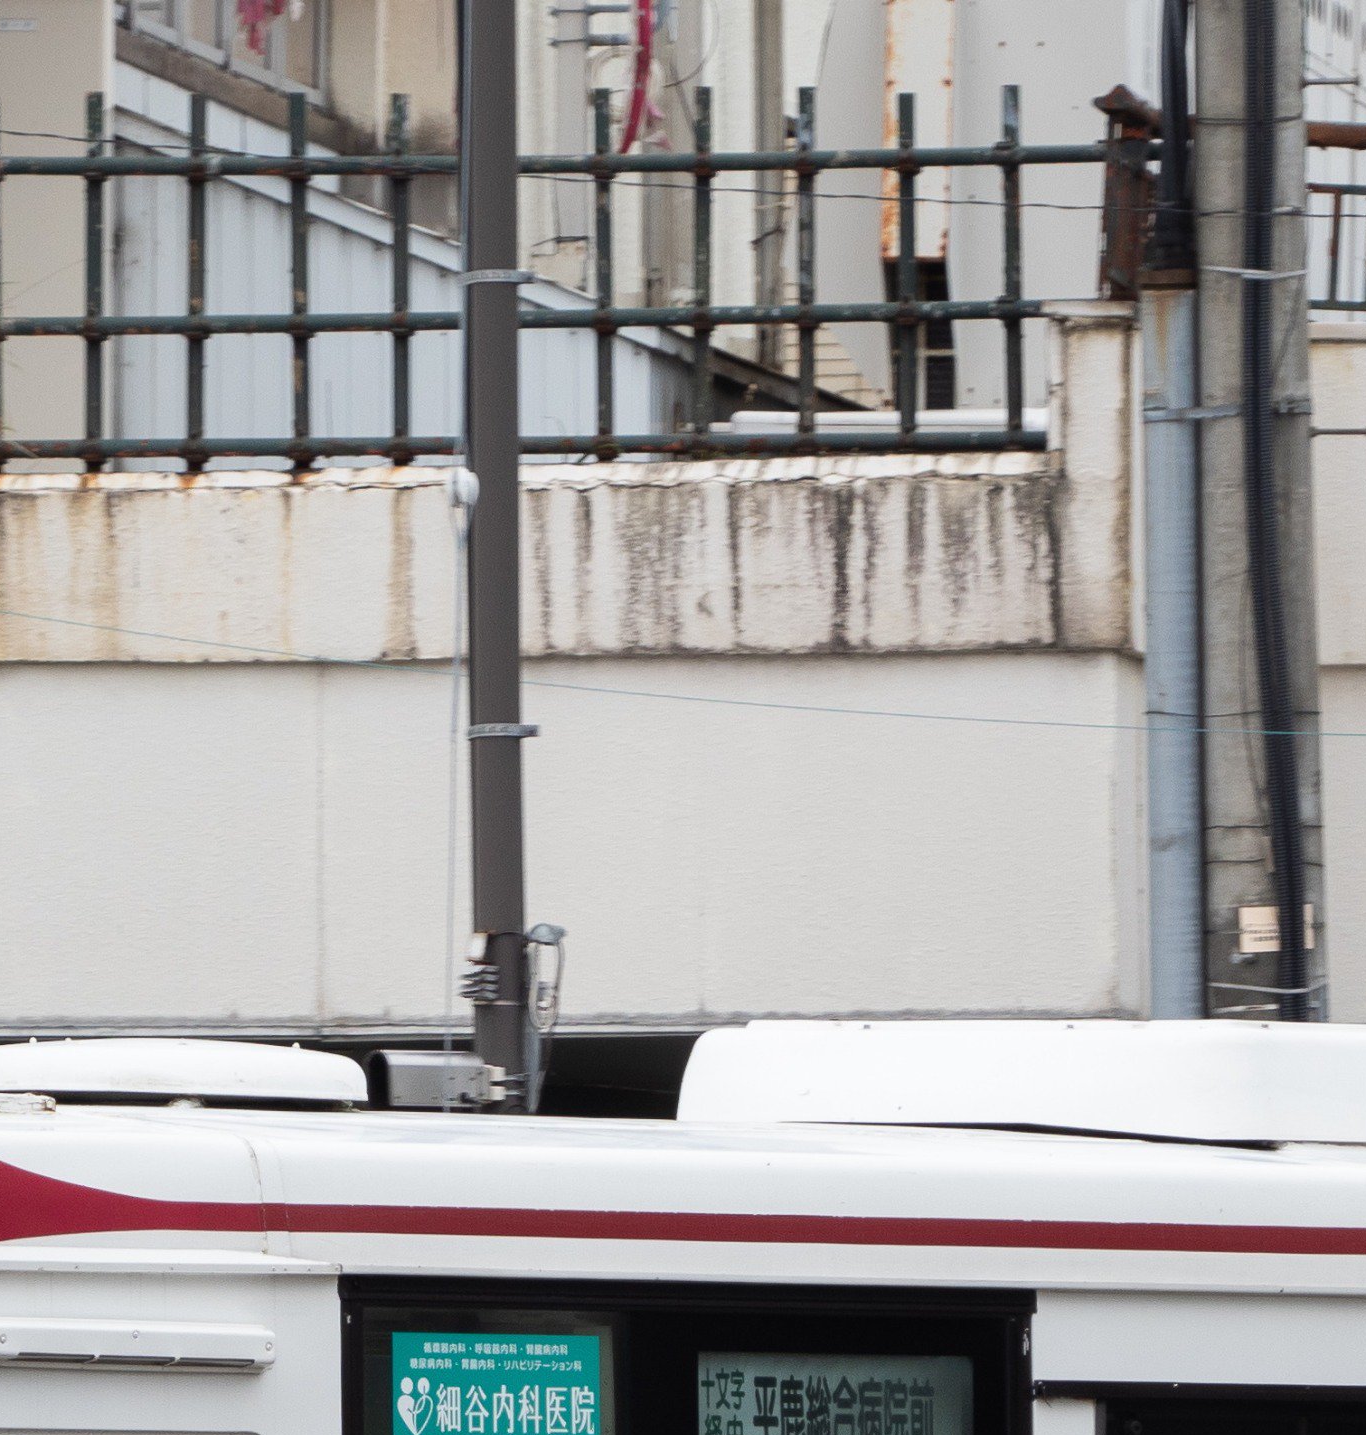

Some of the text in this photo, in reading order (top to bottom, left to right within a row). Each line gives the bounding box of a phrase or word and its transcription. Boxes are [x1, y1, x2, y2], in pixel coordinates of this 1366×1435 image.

[436, 1383, 596, 1435] 細谷内科医院
[701, 1367, 746, 1411] 十文字
